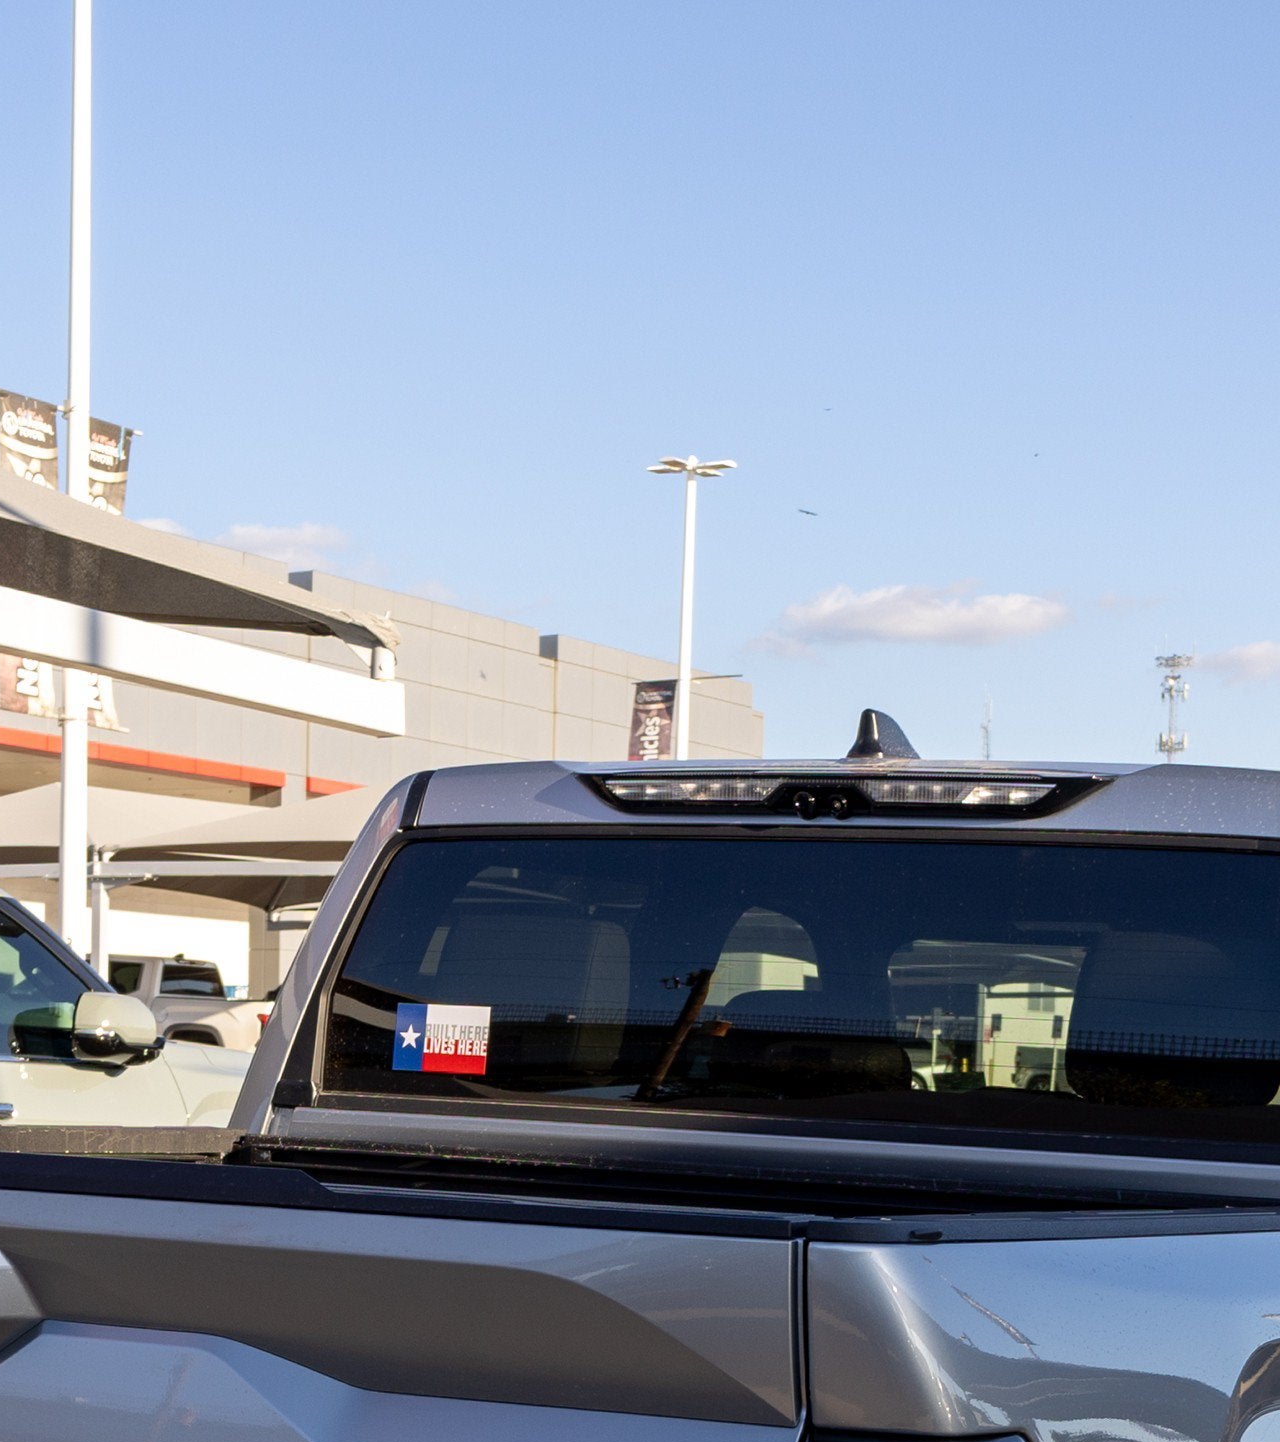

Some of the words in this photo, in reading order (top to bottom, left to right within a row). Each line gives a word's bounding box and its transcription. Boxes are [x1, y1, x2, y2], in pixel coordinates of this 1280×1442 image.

[425, 1023, 457, 1041] BUILT
[458, 1025, 489, 1042] HERE
[423, 1037, 456, 1055] LIVES
[457, 1039, 488, 1056] HERE
